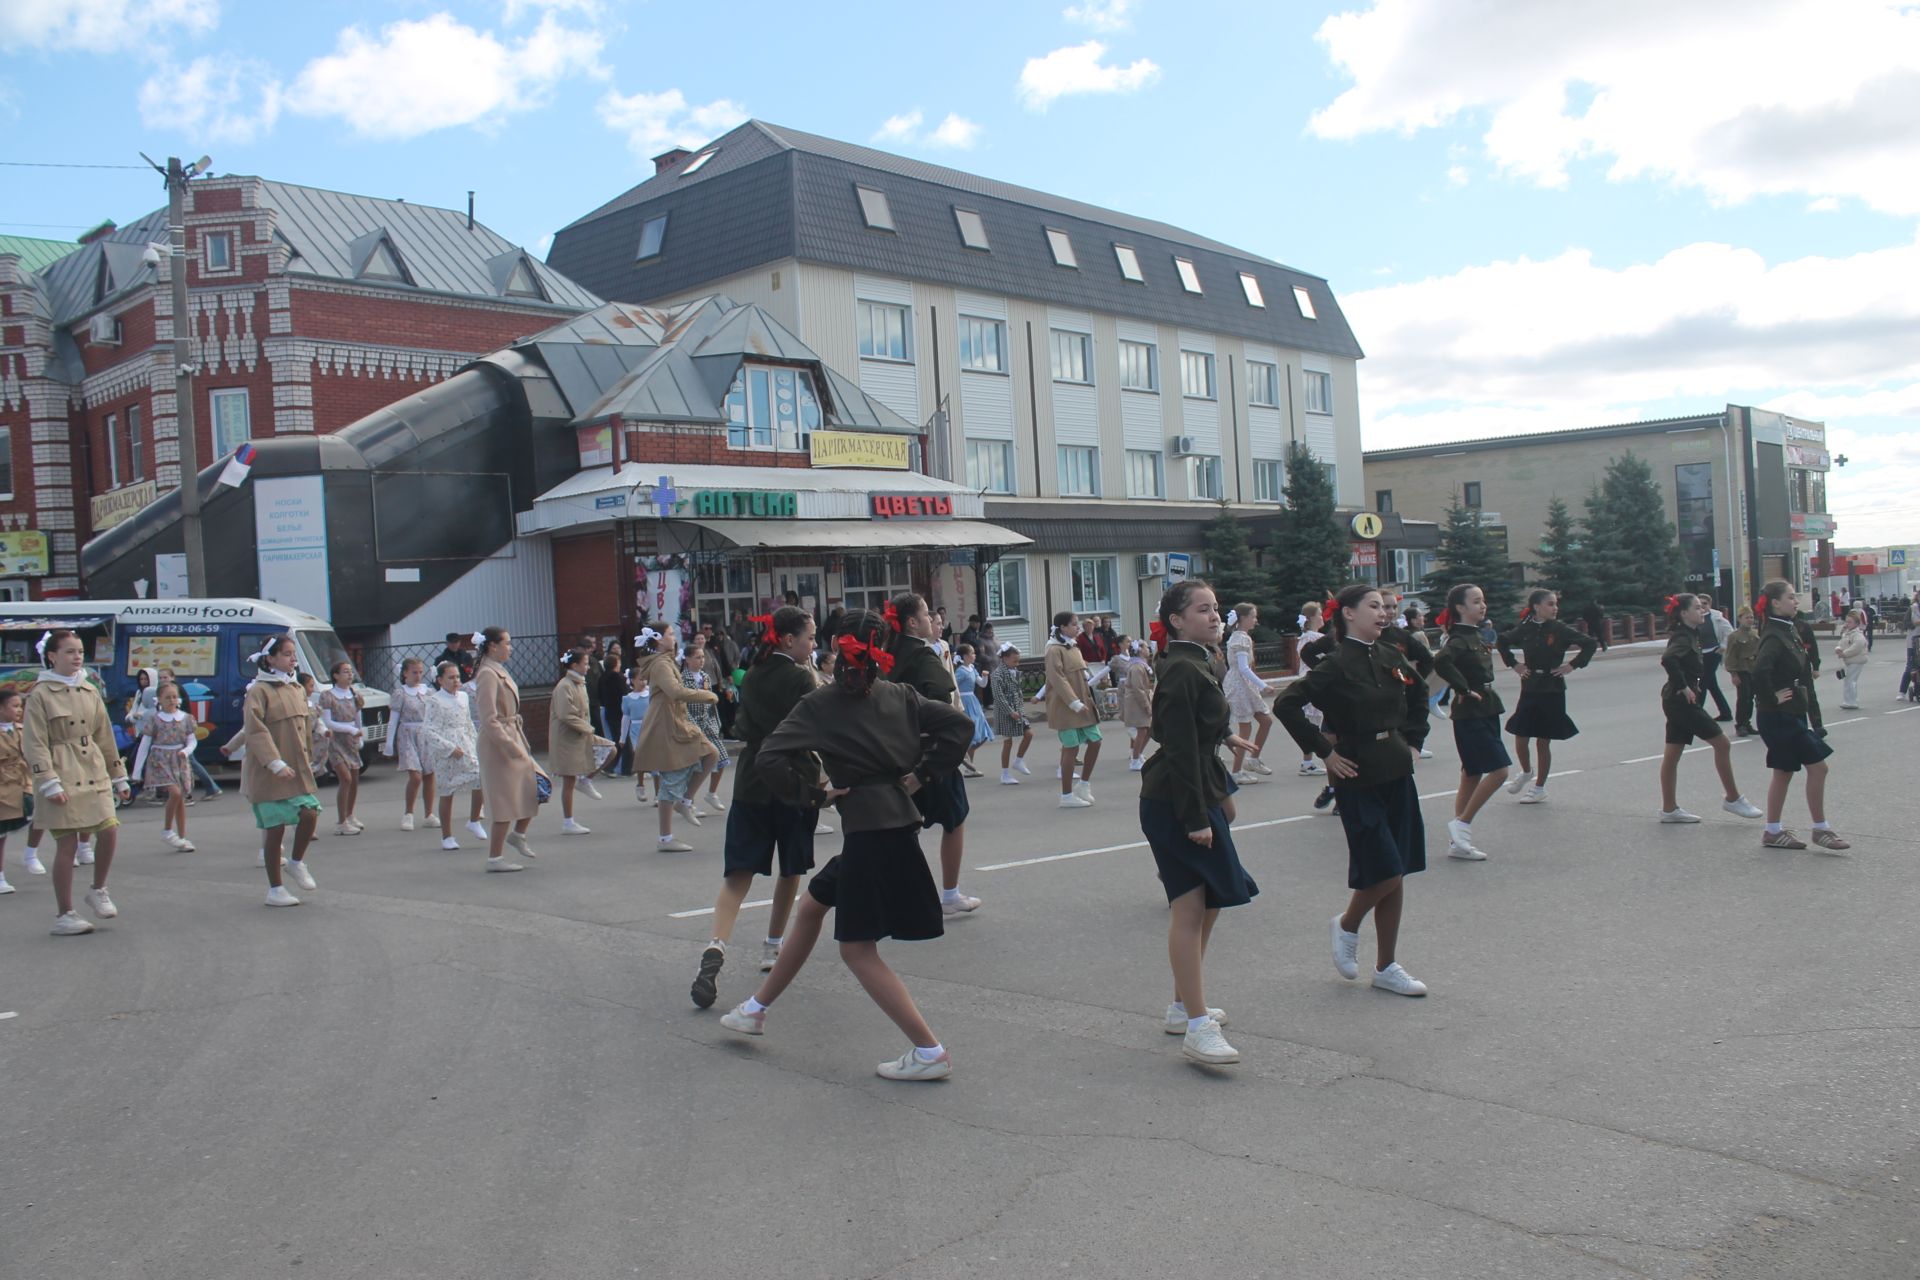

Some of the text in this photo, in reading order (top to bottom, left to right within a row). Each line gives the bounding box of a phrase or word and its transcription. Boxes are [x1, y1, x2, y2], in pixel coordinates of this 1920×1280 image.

[813, 438, 906, 462] ПАРИКМАХЕРСКАЯ
[694, 490, 798, 516] АПТЕКА
[873, 495, 953, 518] ЦВЕТЫ
[268, 510, 310, 520] КОЛГОТКИ
[121, 605, 254, 618] Amazing food
[135, 624, 220, 633] 8996 123-06-59
